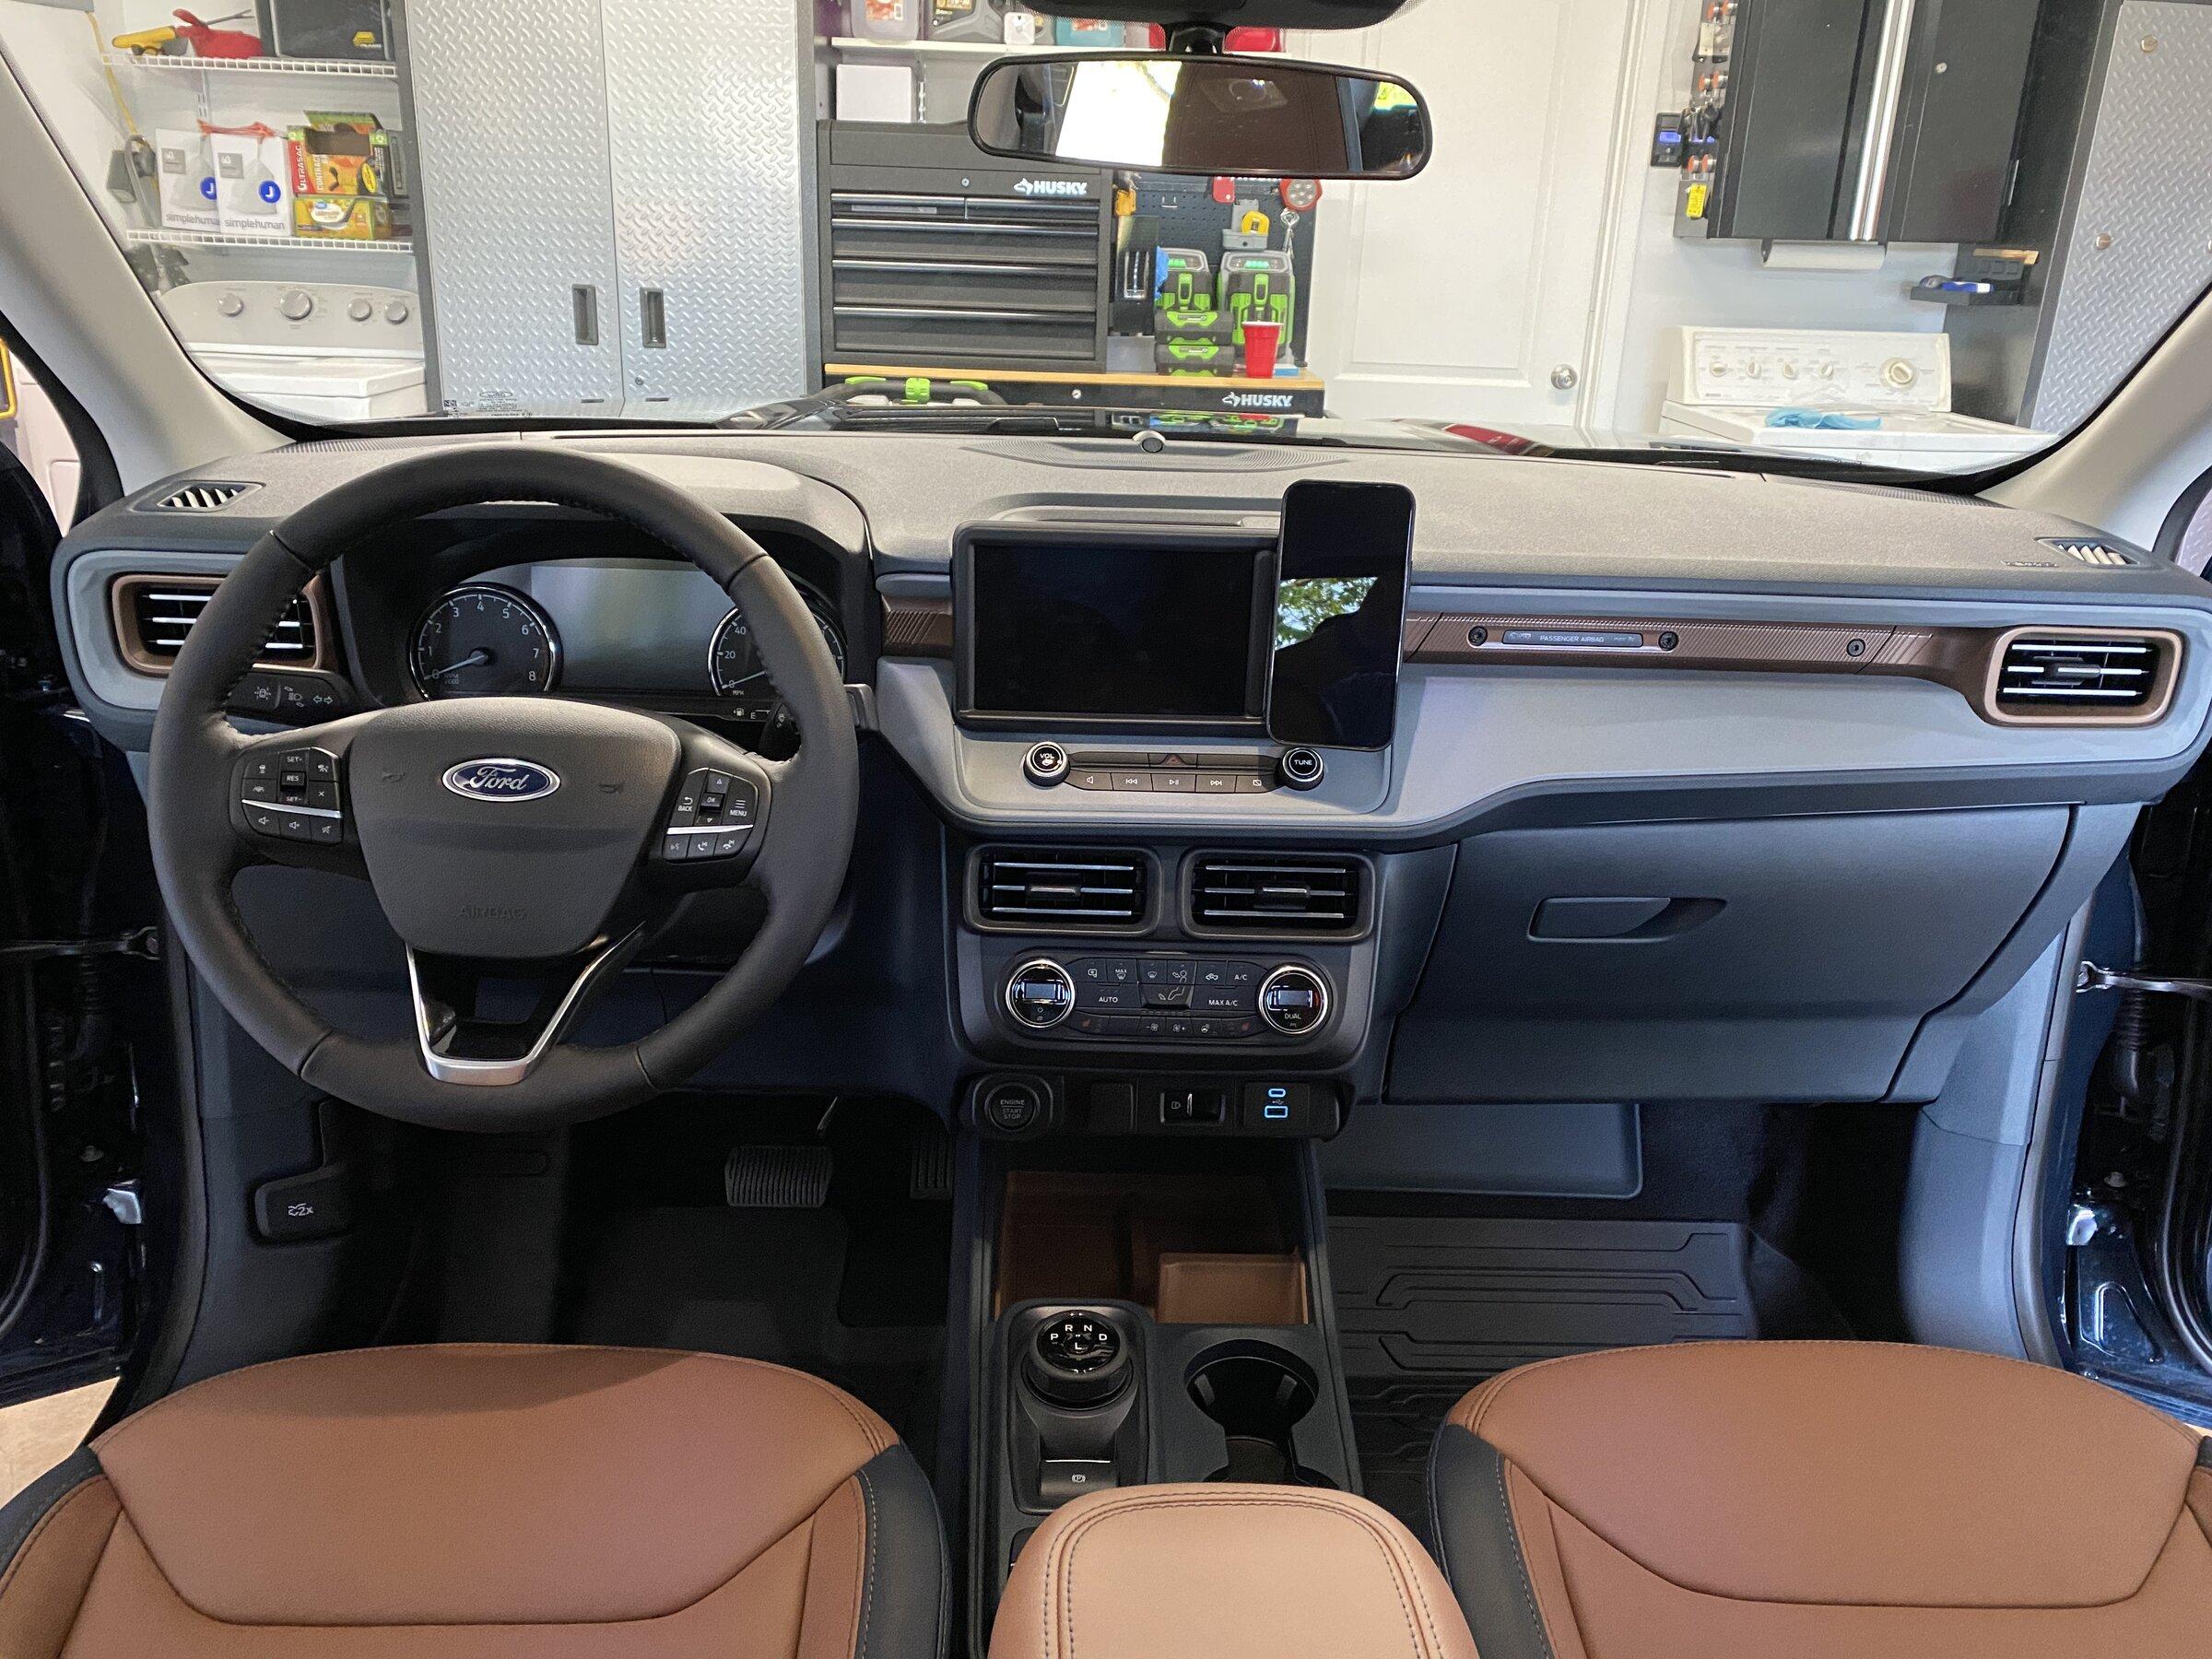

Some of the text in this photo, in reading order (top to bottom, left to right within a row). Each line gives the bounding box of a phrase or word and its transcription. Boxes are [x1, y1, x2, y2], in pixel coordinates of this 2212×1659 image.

[295, 145, 307, 191] ULTRASAC
[265, 185, 275, 197] J
[1033, 180, 1088, 194] HUSKY
[166, 213, 219, 226] simplehuma
[224, 218, 285, 229] simplehuman
[1240, 394, 1294, 407] HUSKY
[477, 601, 485, 611] 4
[453, 607, 460, 617] 3
[501, 608, 510, 618] 5
[435, 623, 441, 633] 2
[521, 624, 529, 635] 6
[734, 627, 747, 635] 40
[428, 646, 432, 655] 1
[533, 648, 539, 658] 7
[724, 651, 736, 659] 20
[528, 671, 536, 680] 8
[750, 712, 757, 720] E
[469, 766, 530, 791] Ford
[1050, 1333, 1059, 1341] P
